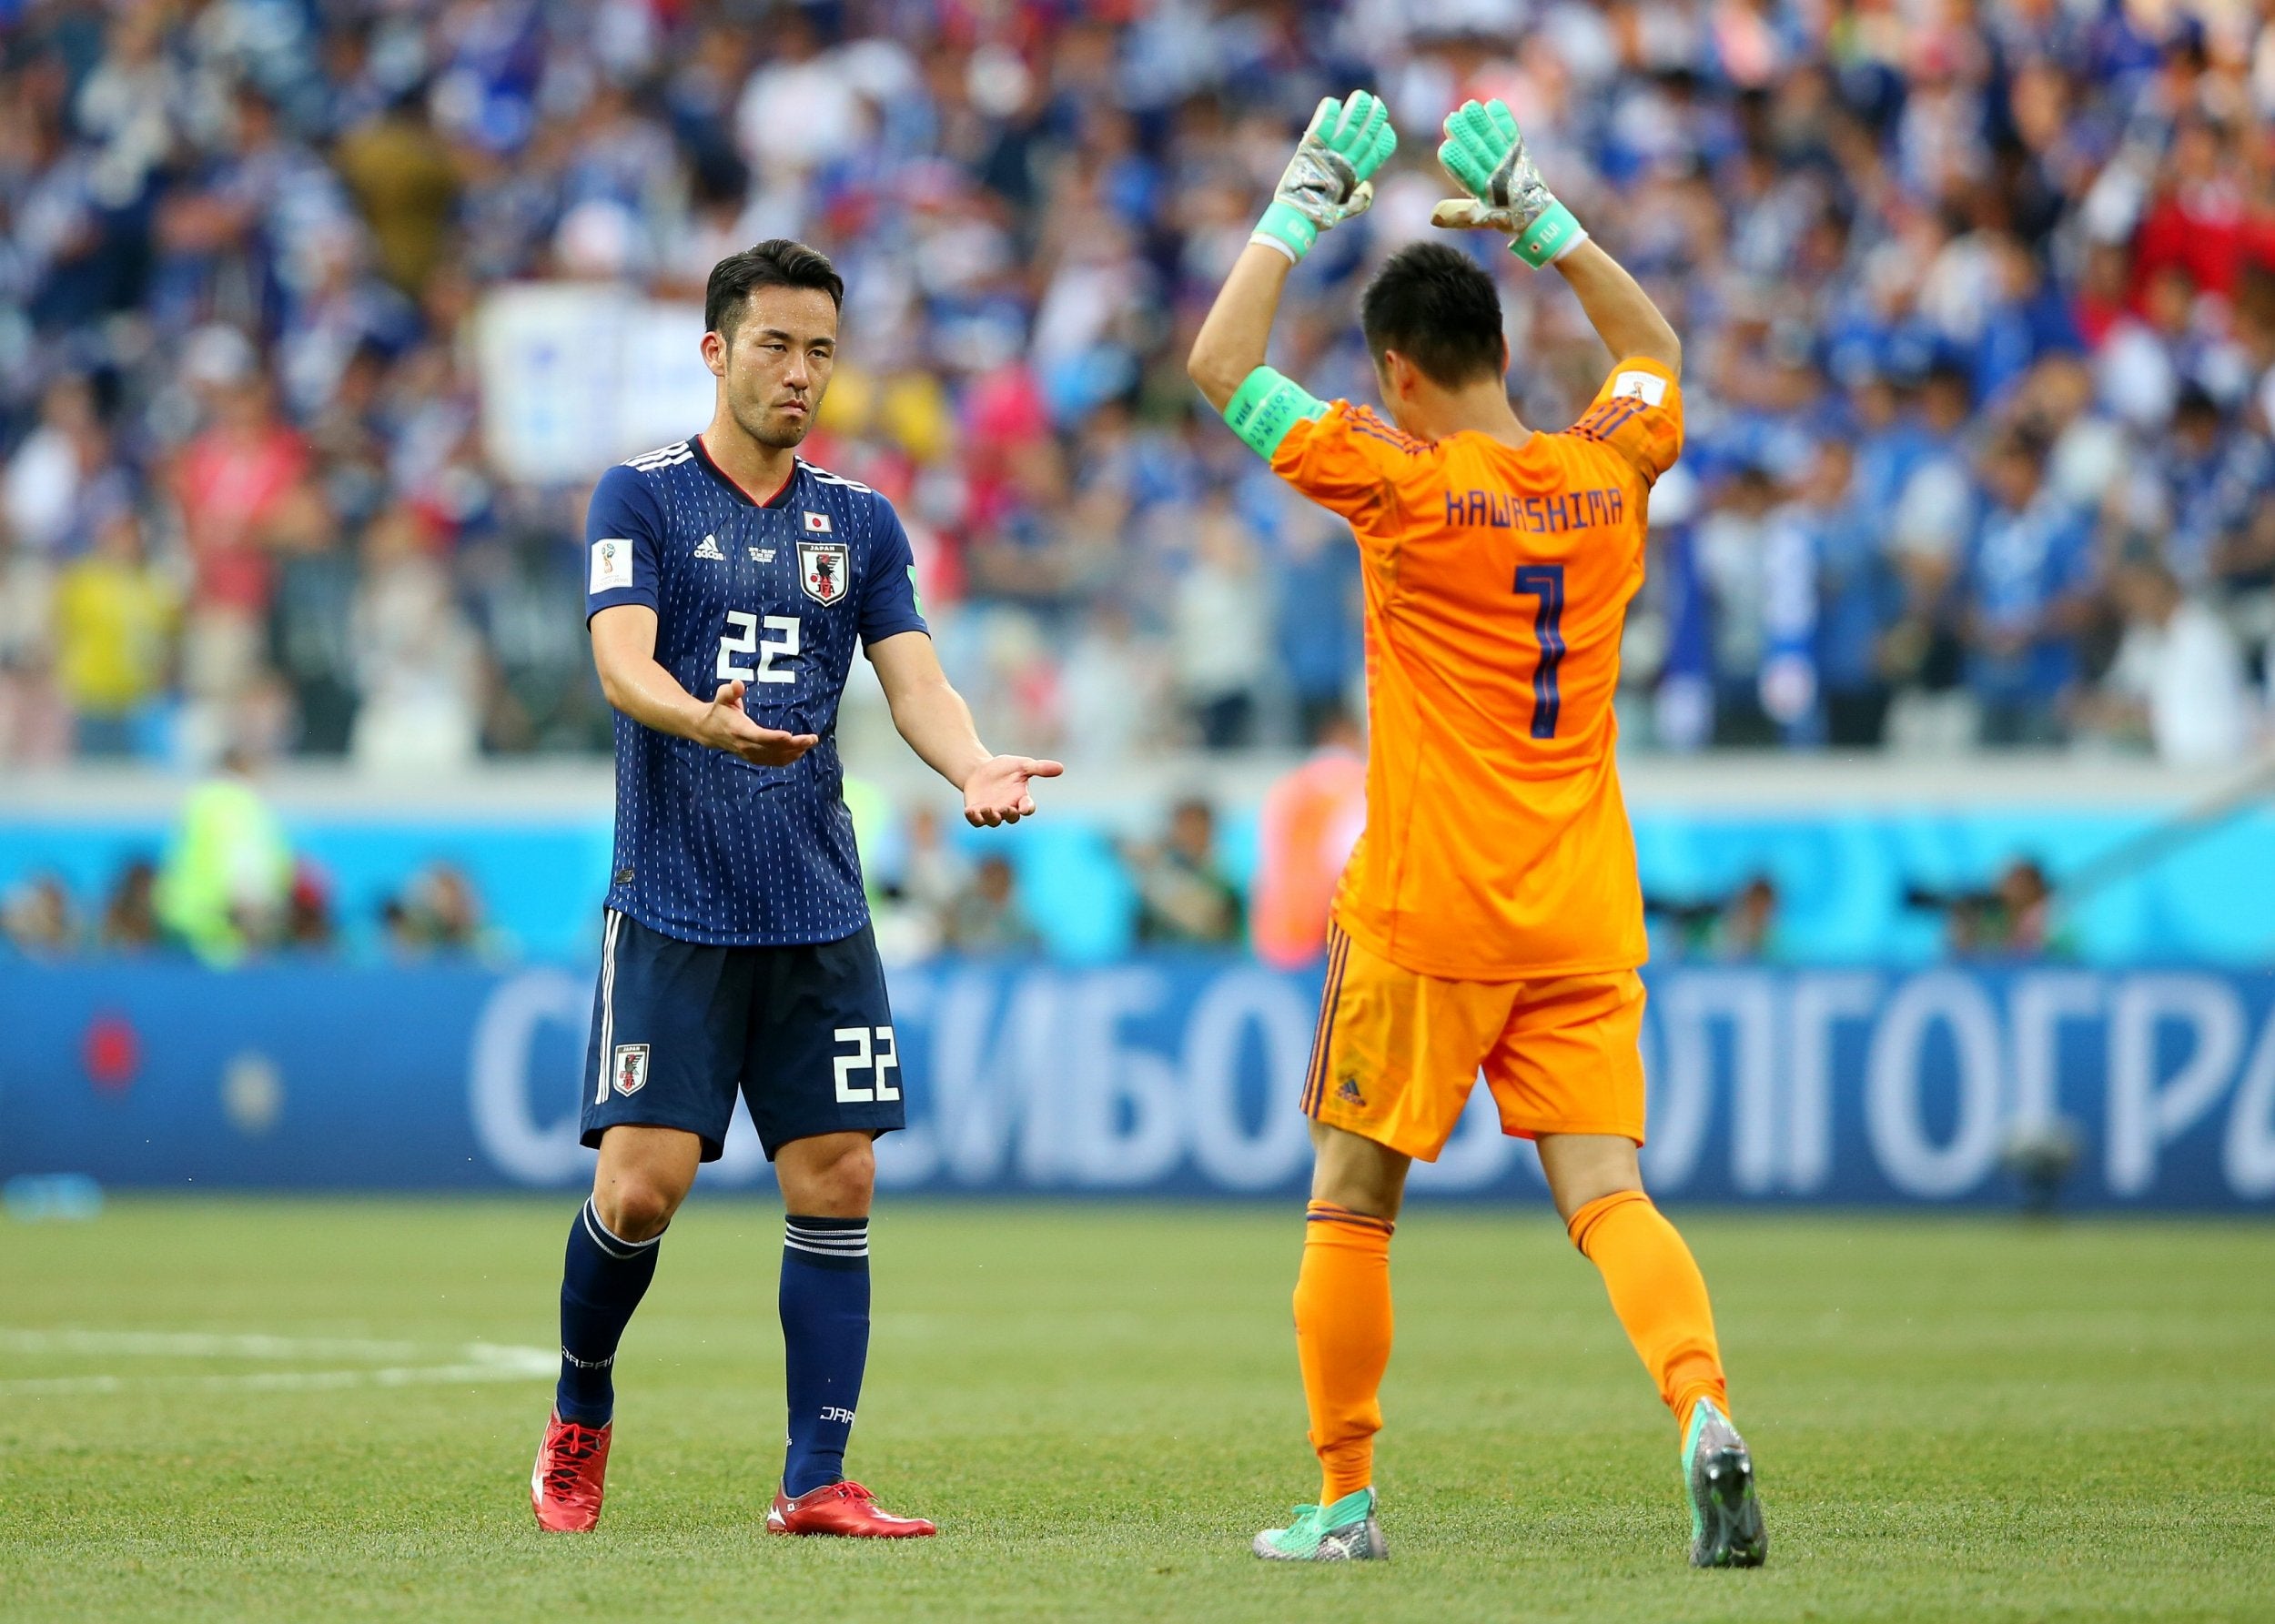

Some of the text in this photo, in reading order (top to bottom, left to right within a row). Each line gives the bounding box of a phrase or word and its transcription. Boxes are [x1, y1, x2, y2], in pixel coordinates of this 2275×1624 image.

[1234, 400, 1252, 426] FIFA
[1445, 489, 1623, 533] KAWASHIMA
[694, 550, 724, 561] adidas
[815, 584, 835, 594] JFA
[716, 610, 801, 684] 22
[1512, 564, 1566, 739] 1
[834, 1026, 900, 1103] 22
